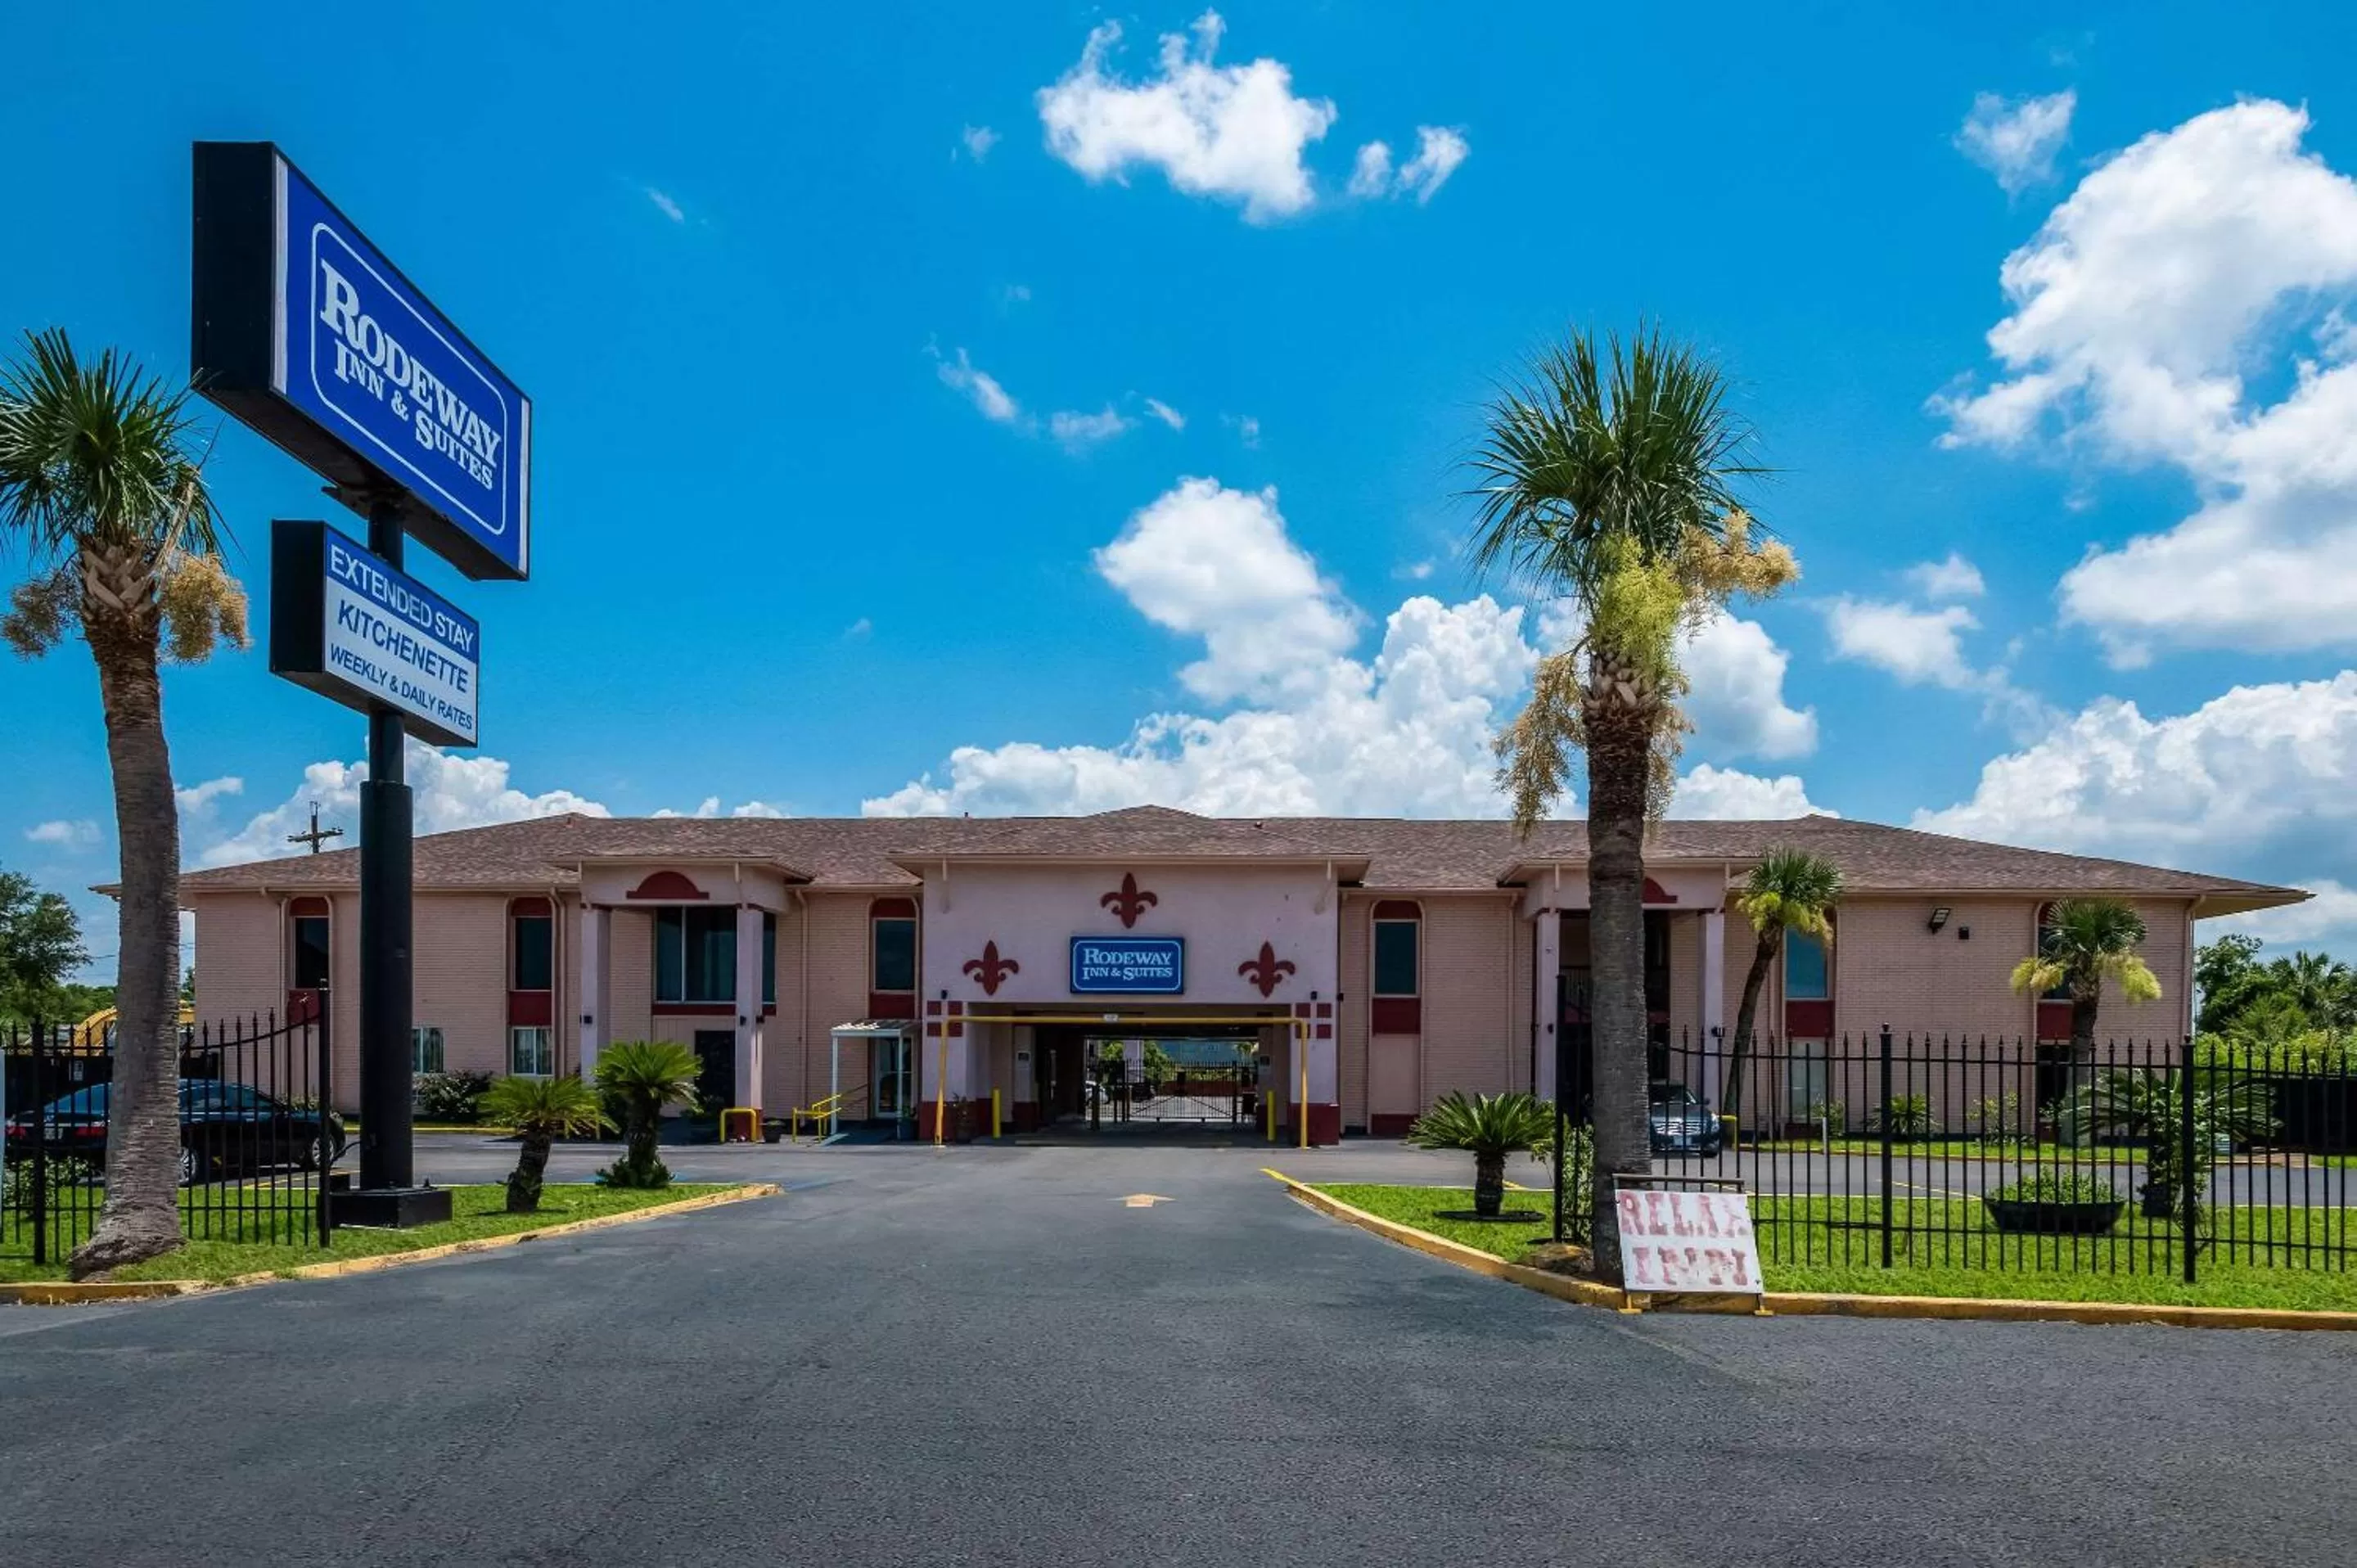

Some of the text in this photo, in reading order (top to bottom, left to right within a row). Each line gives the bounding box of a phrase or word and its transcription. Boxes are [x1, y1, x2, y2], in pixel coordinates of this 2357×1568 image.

[320, 258, 501, 467] RODEWAY
[334, 338, 493, 490] INN & SUITES
[331, 543, 475, 653] EXTENDED STAY
[331, 642, 473, 730] WEEKLY & DAILY RATES
[337, 599, 469, 693] KITCHENETTE
[1082, 967, 1173, 980] INN & SUITES
[1083, 948, 1172, 965] RODEWAY
